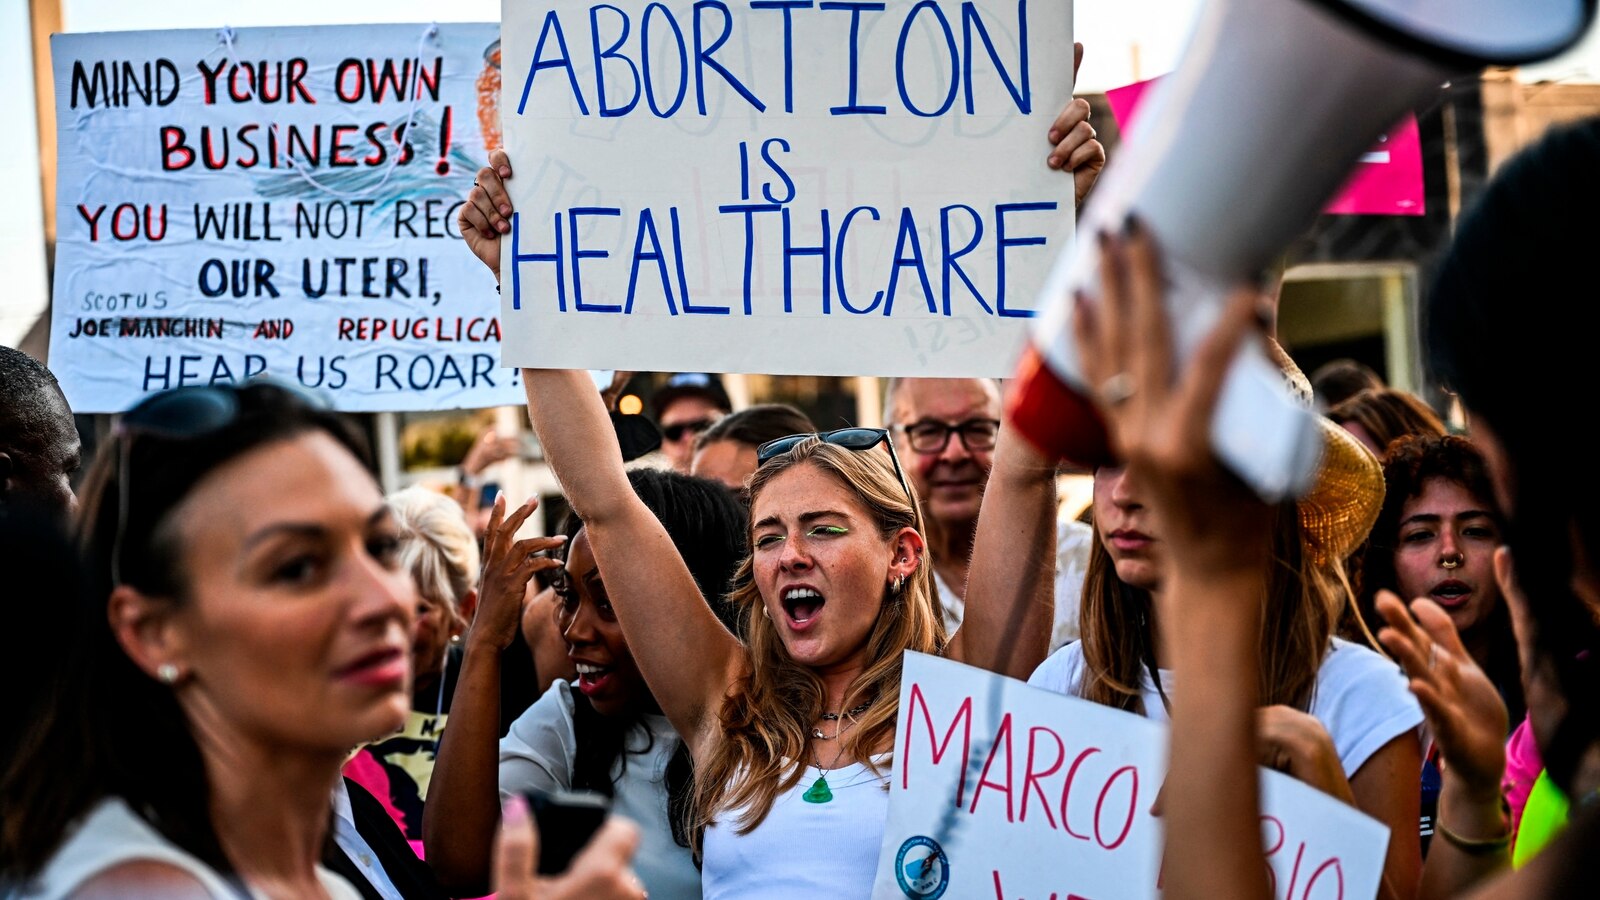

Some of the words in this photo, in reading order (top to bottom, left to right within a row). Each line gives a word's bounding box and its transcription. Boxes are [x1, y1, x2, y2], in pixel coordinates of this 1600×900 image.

[70, 58, 180, 109] MIND
[197, 57, 317, 106] YOUR
[335, 57, 443, 104] OWN
[518, 0, 1031, 118] ABORTION
[739, 137, 796, 204] IS
[77, 202, 168, 242] YOU
[194, 200, 282, 241] WILL
[295, 199, 375, 239] NOT
[198, 258, 280, 299] OUR
[301, 257, 442, 306] UTERI,
[511, 201, 1058, 318] HEALTHCARE
[80, 291, 168, 312] SCOTUS
[69, 317, 111, 339] JOE
[118, 316, 224, 340] MANCHIN
[252, 317, 294, 340] AND
[297, 355, 347, 391] US
[902, 683, 1139, 850] MARCO
